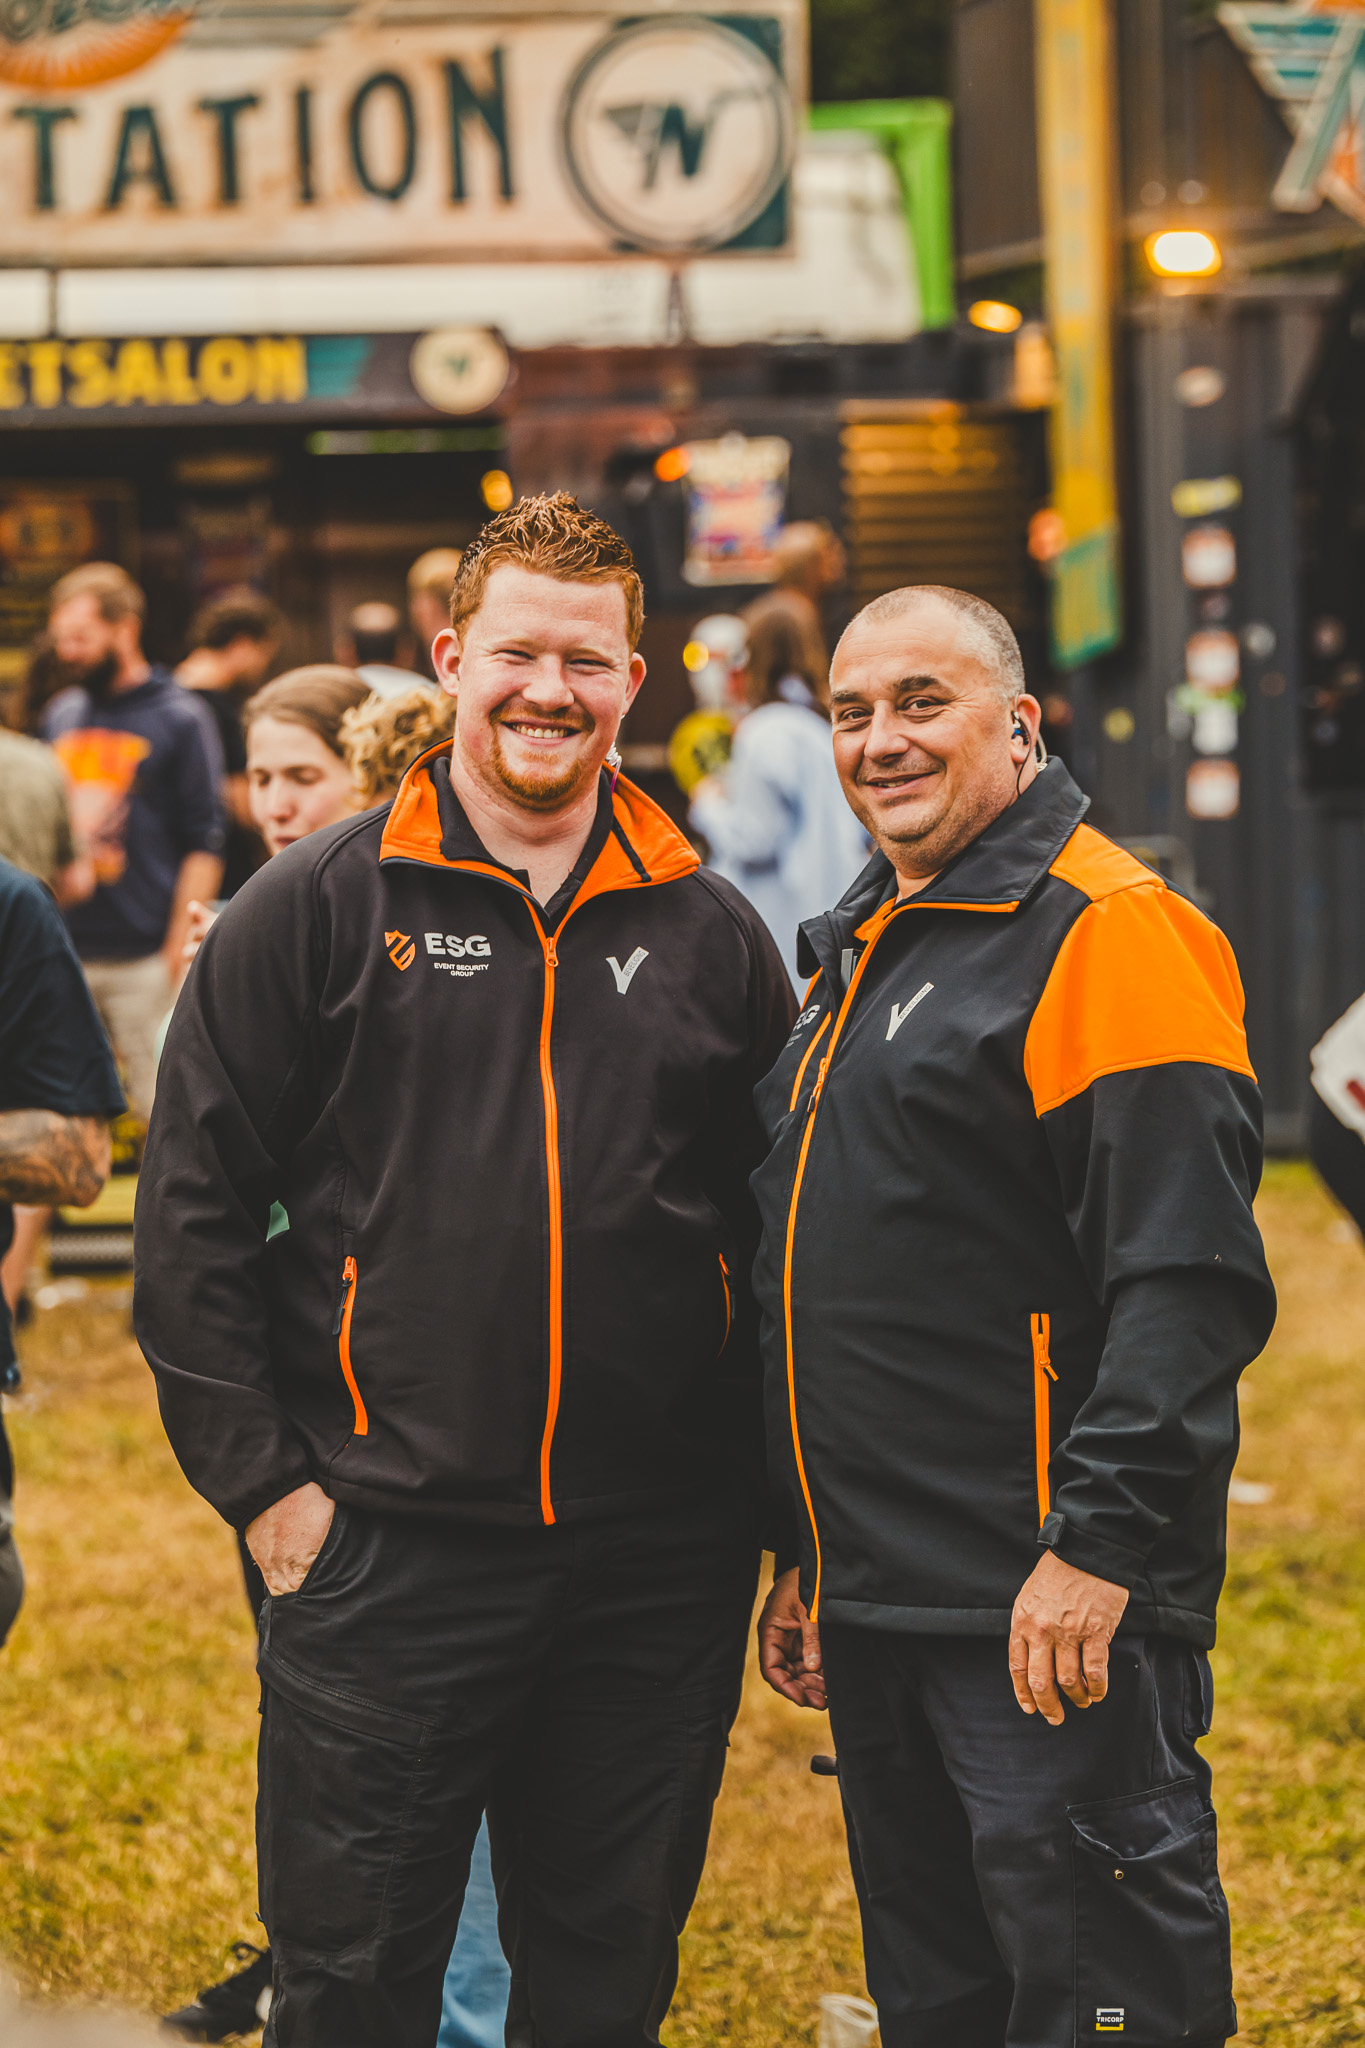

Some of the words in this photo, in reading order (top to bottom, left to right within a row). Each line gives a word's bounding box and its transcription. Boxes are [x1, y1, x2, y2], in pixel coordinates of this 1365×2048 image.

[13, 45, 515, 212] TATION
[424, 932, 492, 958] ESG
[433, 962, 455, 971] EVENT
[456, 963, 489, 971] SECURITY
